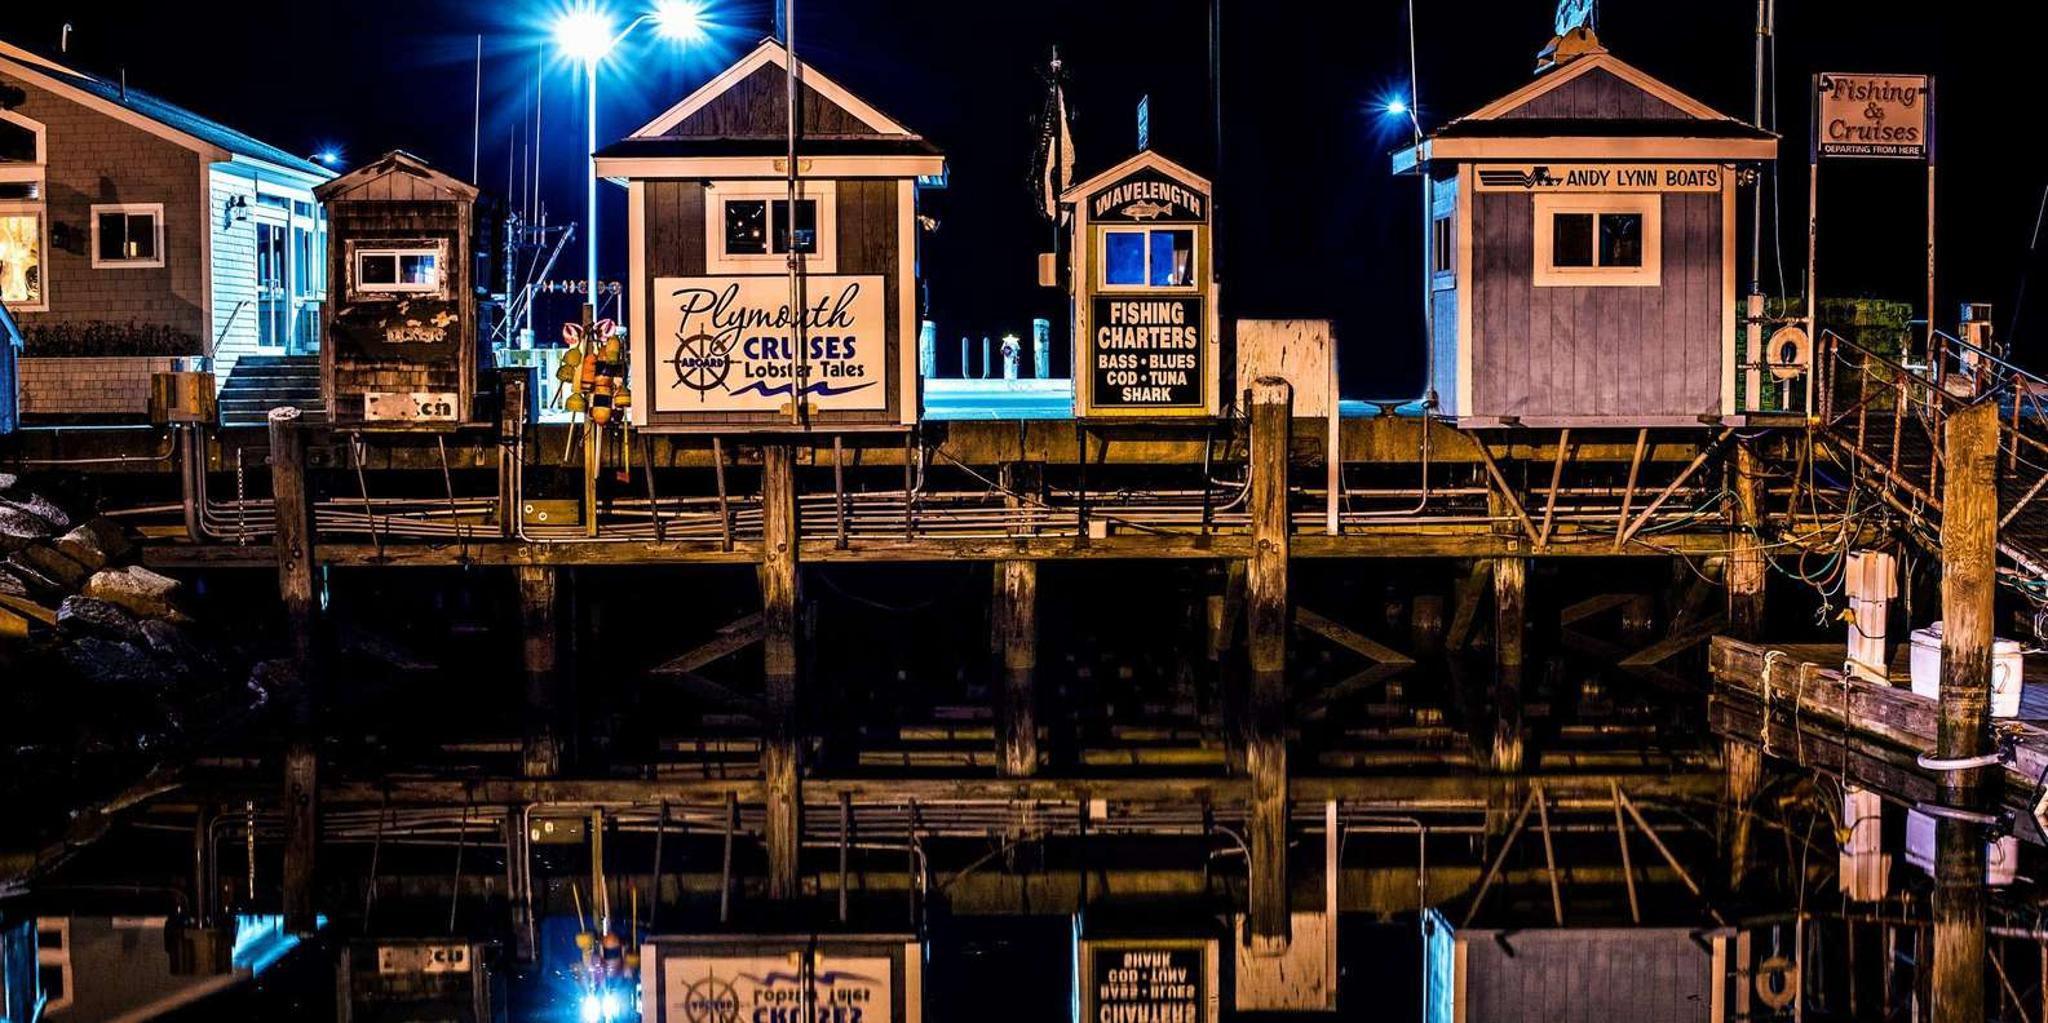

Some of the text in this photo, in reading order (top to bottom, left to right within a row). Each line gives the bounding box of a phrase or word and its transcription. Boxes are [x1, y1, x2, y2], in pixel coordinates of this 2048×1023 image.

[1831, 78, 1916, 107] Fishing
[1864, 102, 1885, 119] &
[1829, 119, 1919, 141] Cruises
[1825, 145, 1920, 154] DEPARTING FROM HERE
[1567, 170, 1717, 186] ANDY LYNN BOATS
[1096, 181, 1201, 217] WAVELENGTH
[672, 283, 860, 356] Plymouth
[1110, 302, 1184, 324] FISHING
[1098, 326, 1197, 349] CHARTERS
[681, 357, 724, 368] ABOARD
[745, 361, 864, 378] Lobster Tales
[1099, 354, 1196, 369] BASS BLUES
[1106, 371, 1188, 386] COD TUNA
[1122, 387, 1171, 402] SHARK
